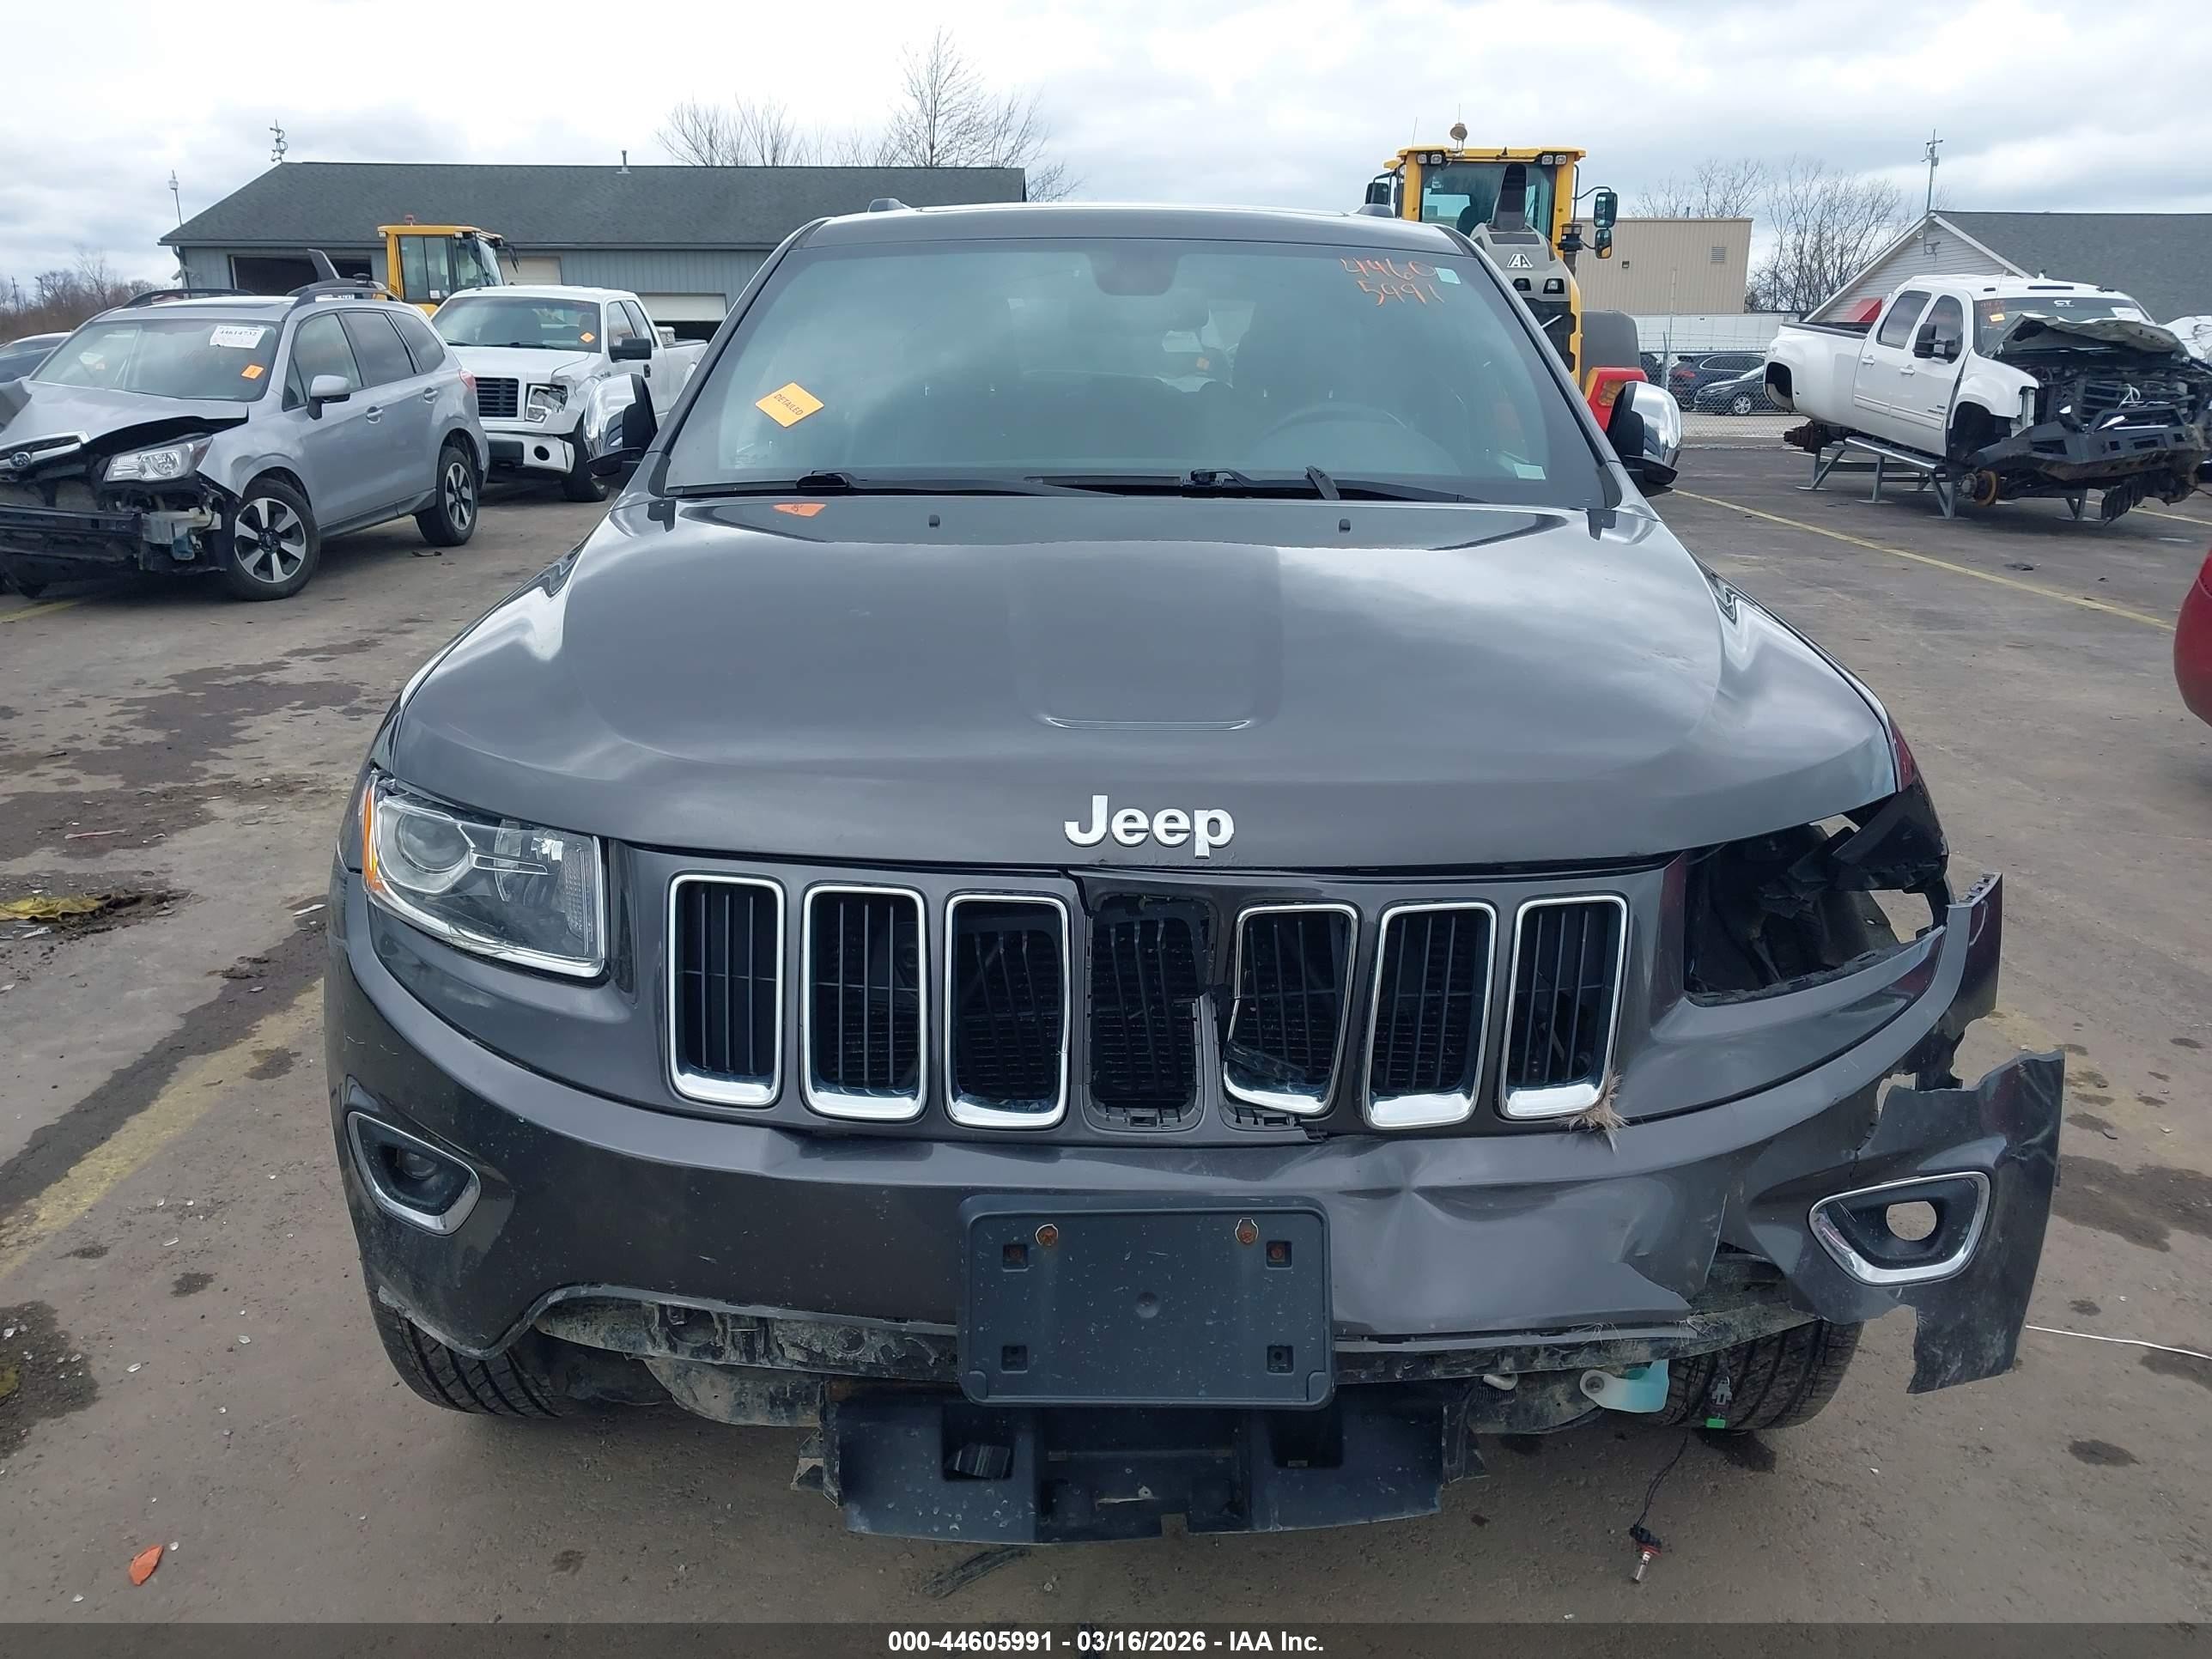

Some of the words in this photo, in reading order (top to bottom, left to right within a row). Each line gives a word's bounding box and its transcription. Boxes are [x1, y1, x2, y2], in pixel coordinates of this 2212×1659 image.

[1356, 280, 1445, 307] 5491
[774, 393, 804, 416] DETAILED
[1064, 793, 1235, 860] Jeep
